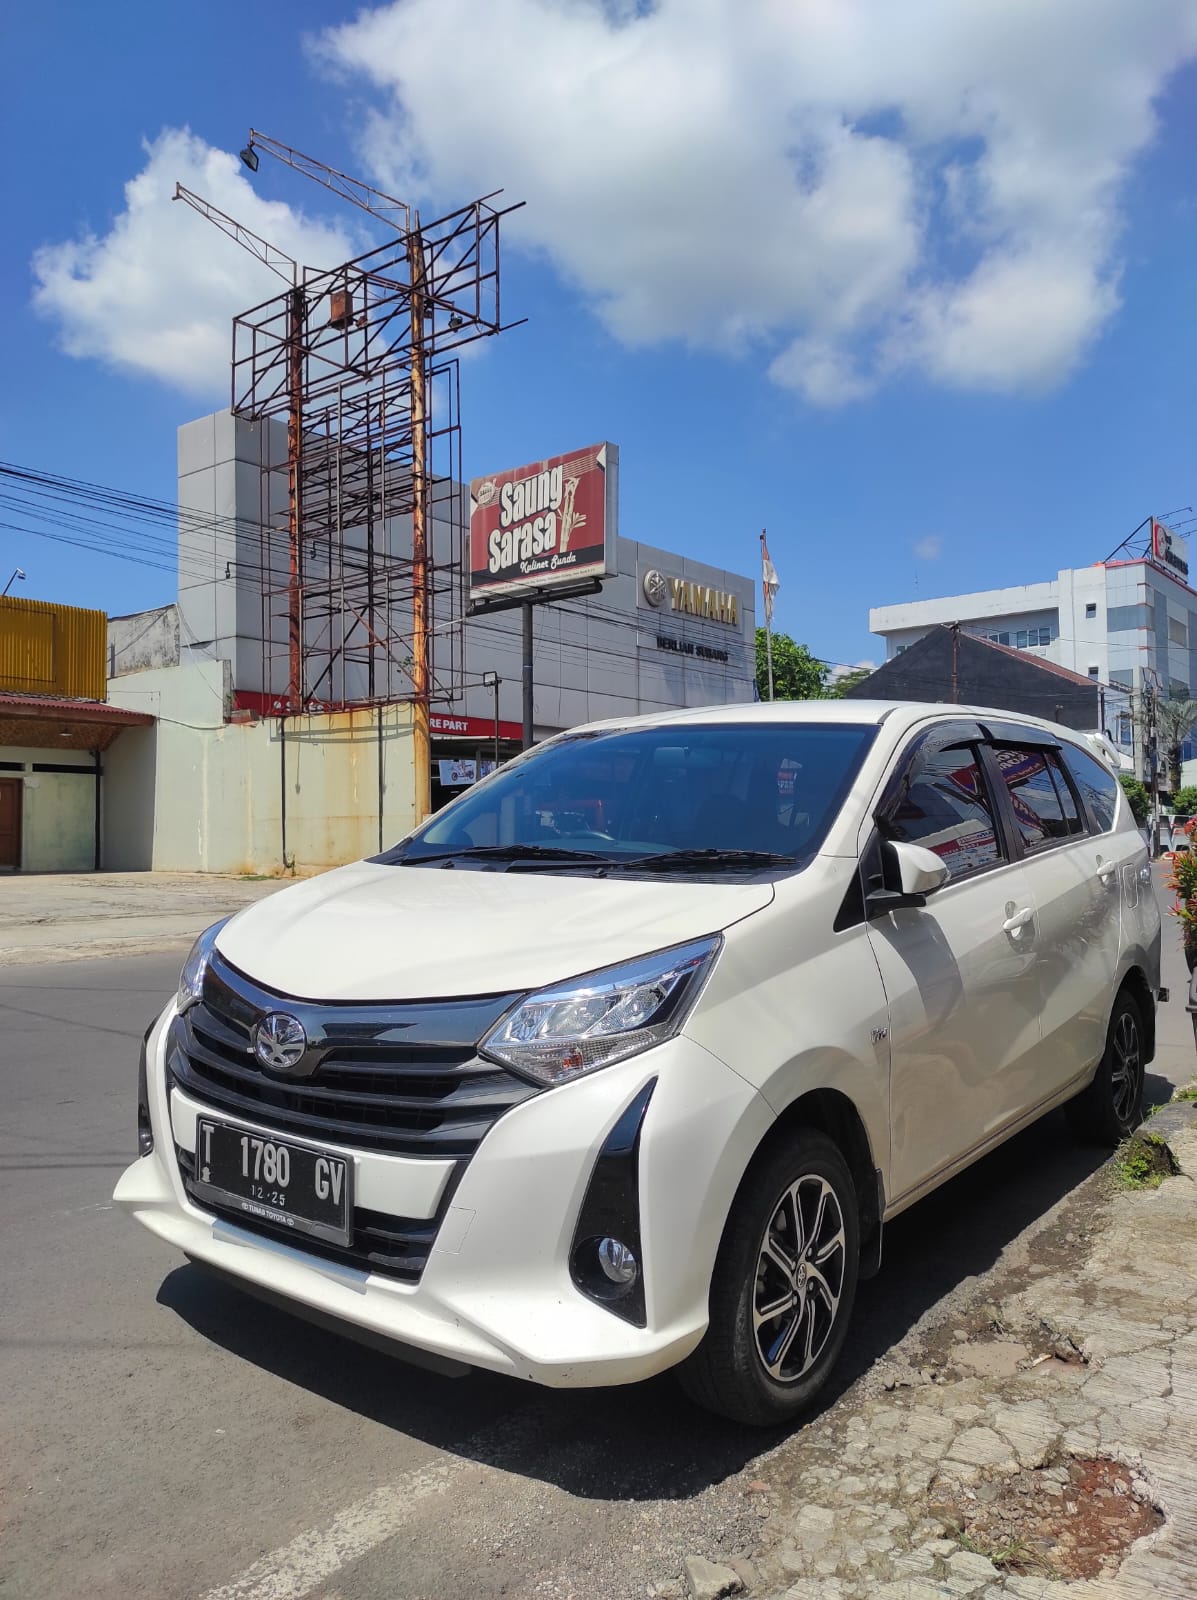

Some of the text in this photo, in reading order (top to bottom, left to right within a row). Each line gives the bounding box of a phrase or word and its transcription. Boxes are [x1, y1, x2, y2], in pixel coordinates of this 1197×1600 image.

[501, 465, 563, 527] Saung
[489, 511, 557, 573] Sarasa
[520, 552, 577, 574] Kuliner Sunda
[671, 578, 738, 626] YAMAHA
[443, 719, 468, 731] PART
[202, 1125, 344, 1205] T 1780 GV
[266, 1210, 287, 1223] TOYOTA
